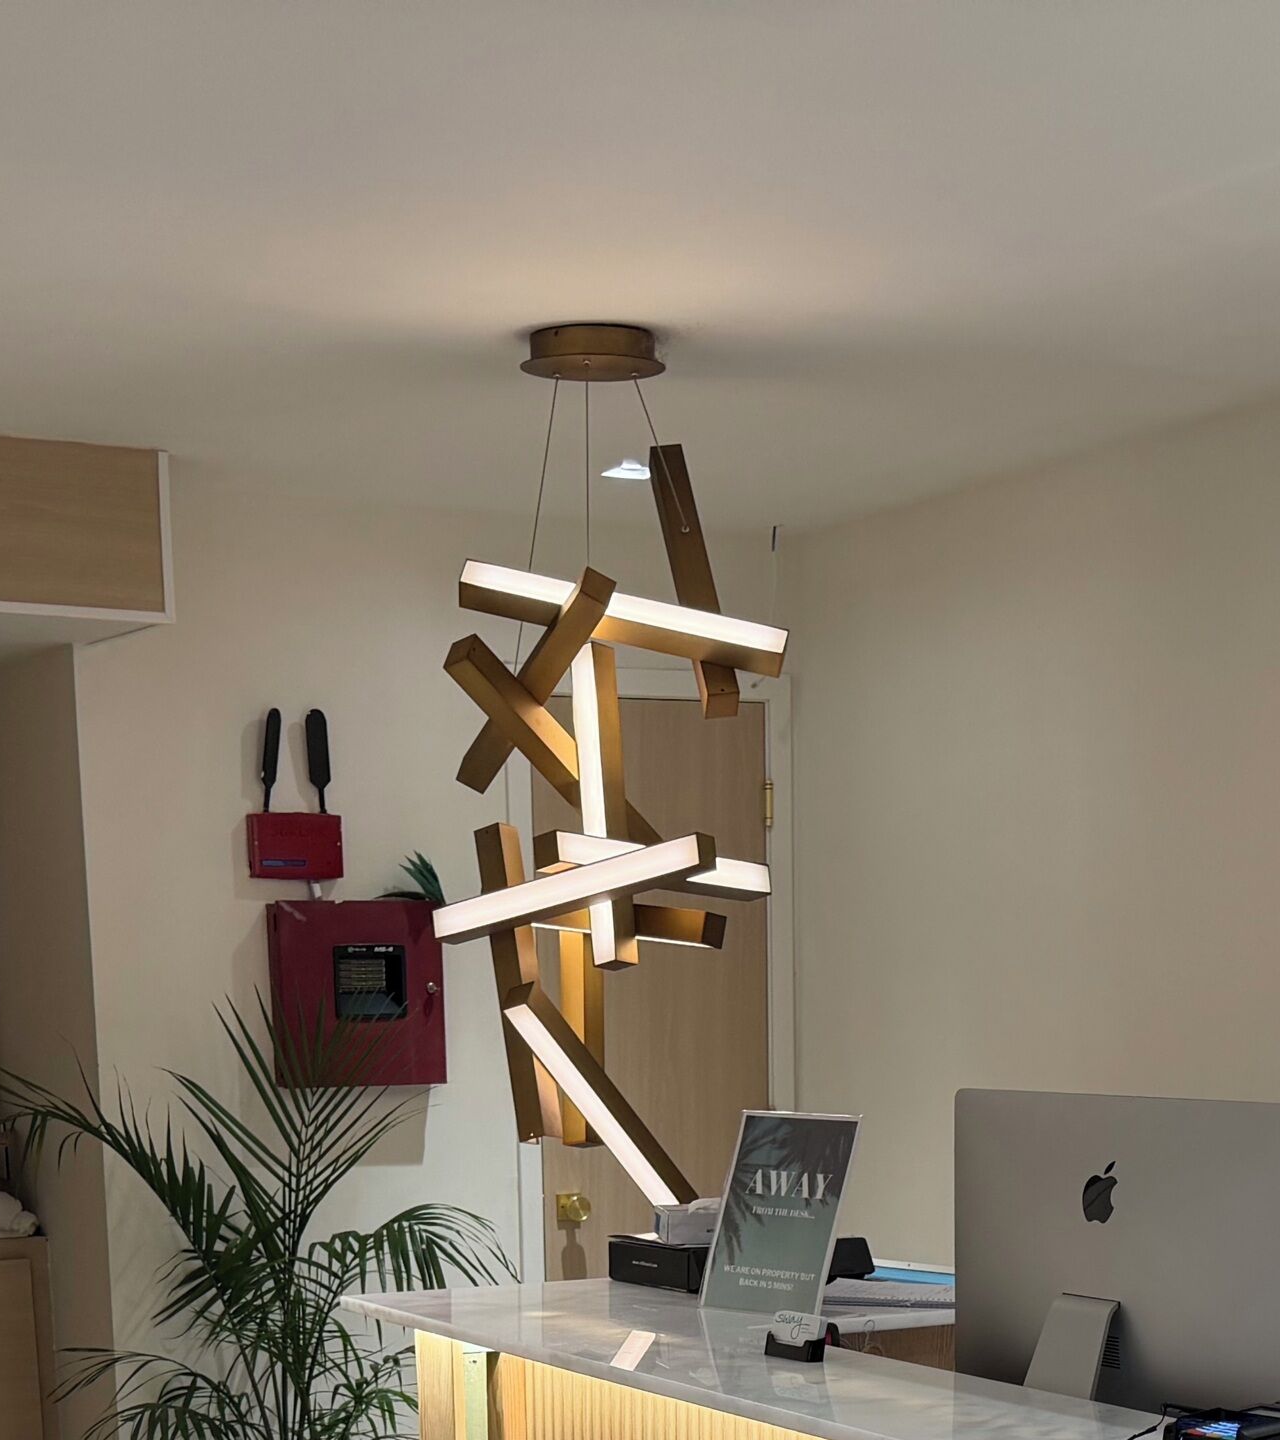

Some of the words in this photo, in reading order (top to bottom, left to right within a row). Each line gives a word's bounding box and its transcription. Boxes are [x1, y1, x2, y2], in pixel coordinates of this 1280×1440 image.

[745, 1168, 833, 1200] AWAY
[736, 1265, 751, 1275] ARE
[751, 1266, 761, 1276] ON
[761, 1267, 800, 1280] PROPERTY
[739, 1277, 758, 1287] BACK
[759, 1279, 767, 1288] IN
